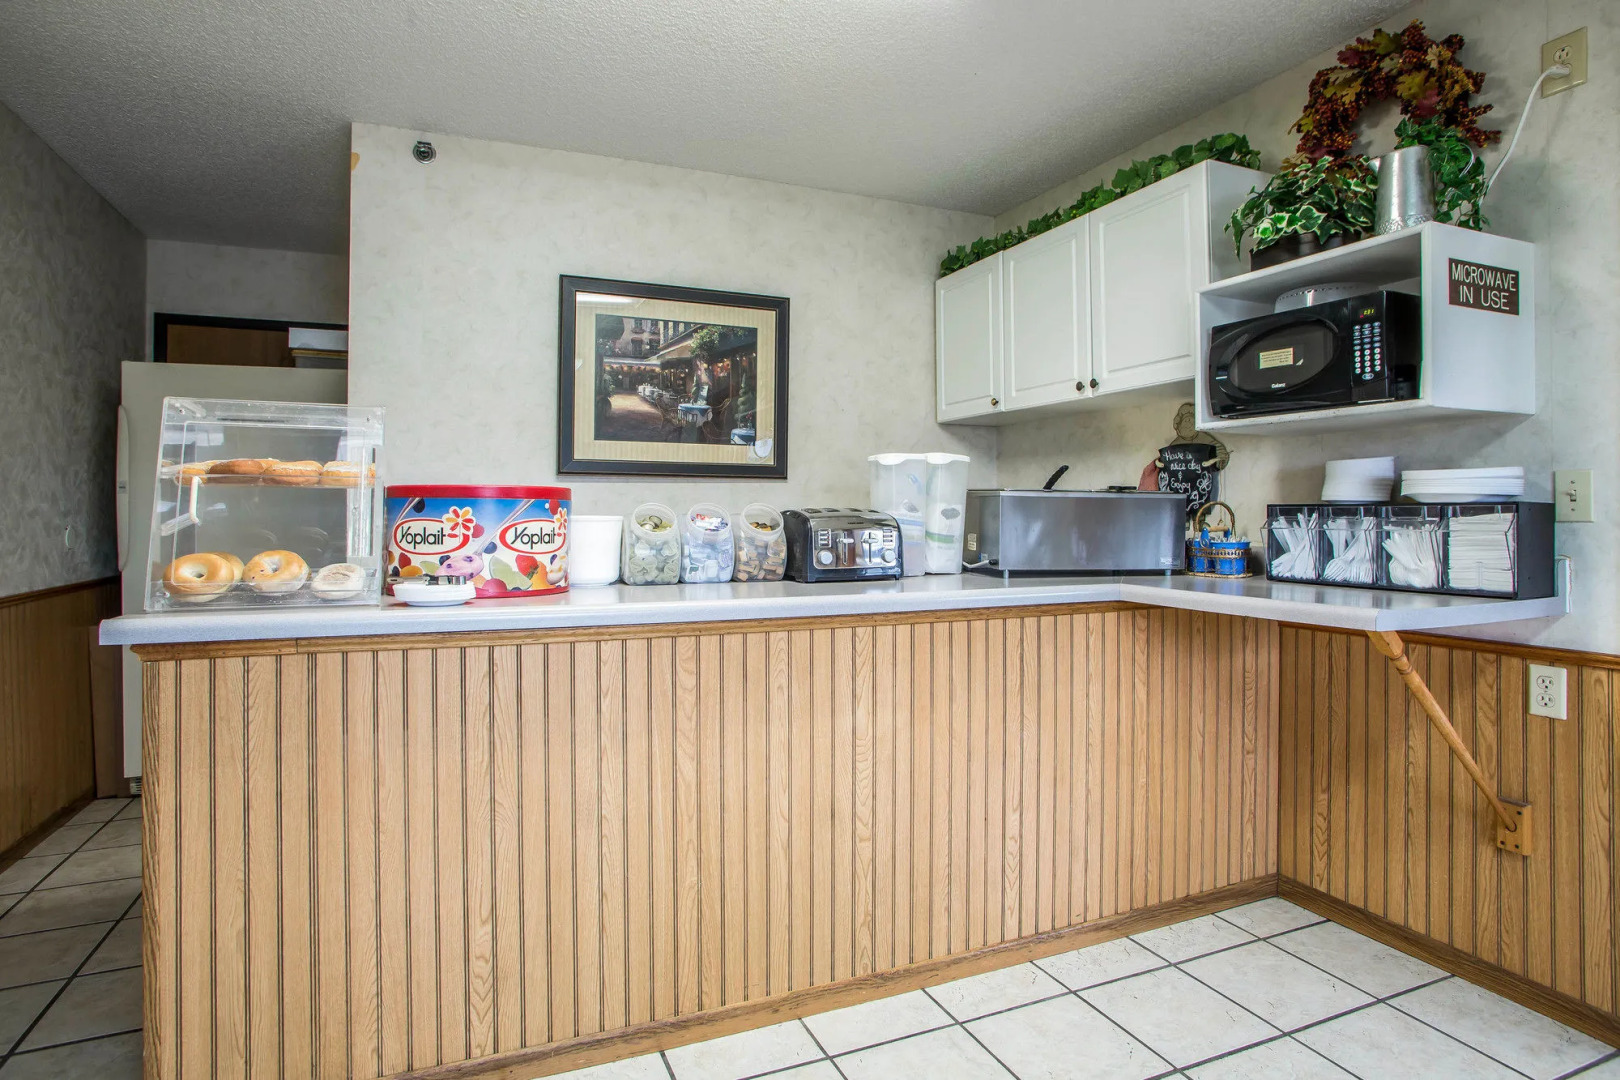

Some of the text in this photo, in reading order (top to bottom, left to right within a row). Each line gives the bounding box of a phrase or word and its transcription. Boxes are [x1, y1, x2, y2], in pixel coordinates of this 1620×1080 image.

[1452, 262, 1517, 291] MICROWAVE
[1460, 284, 1510, 310] IN USE
[1163, 450, 1184, 461] Have
[1187, 458, 1202, 473] day
[1170, 477, 1191, 495] Enjoy
[399, 526, 446, 549] Yoplait
[510, 526, 556, 550] Yoplait
